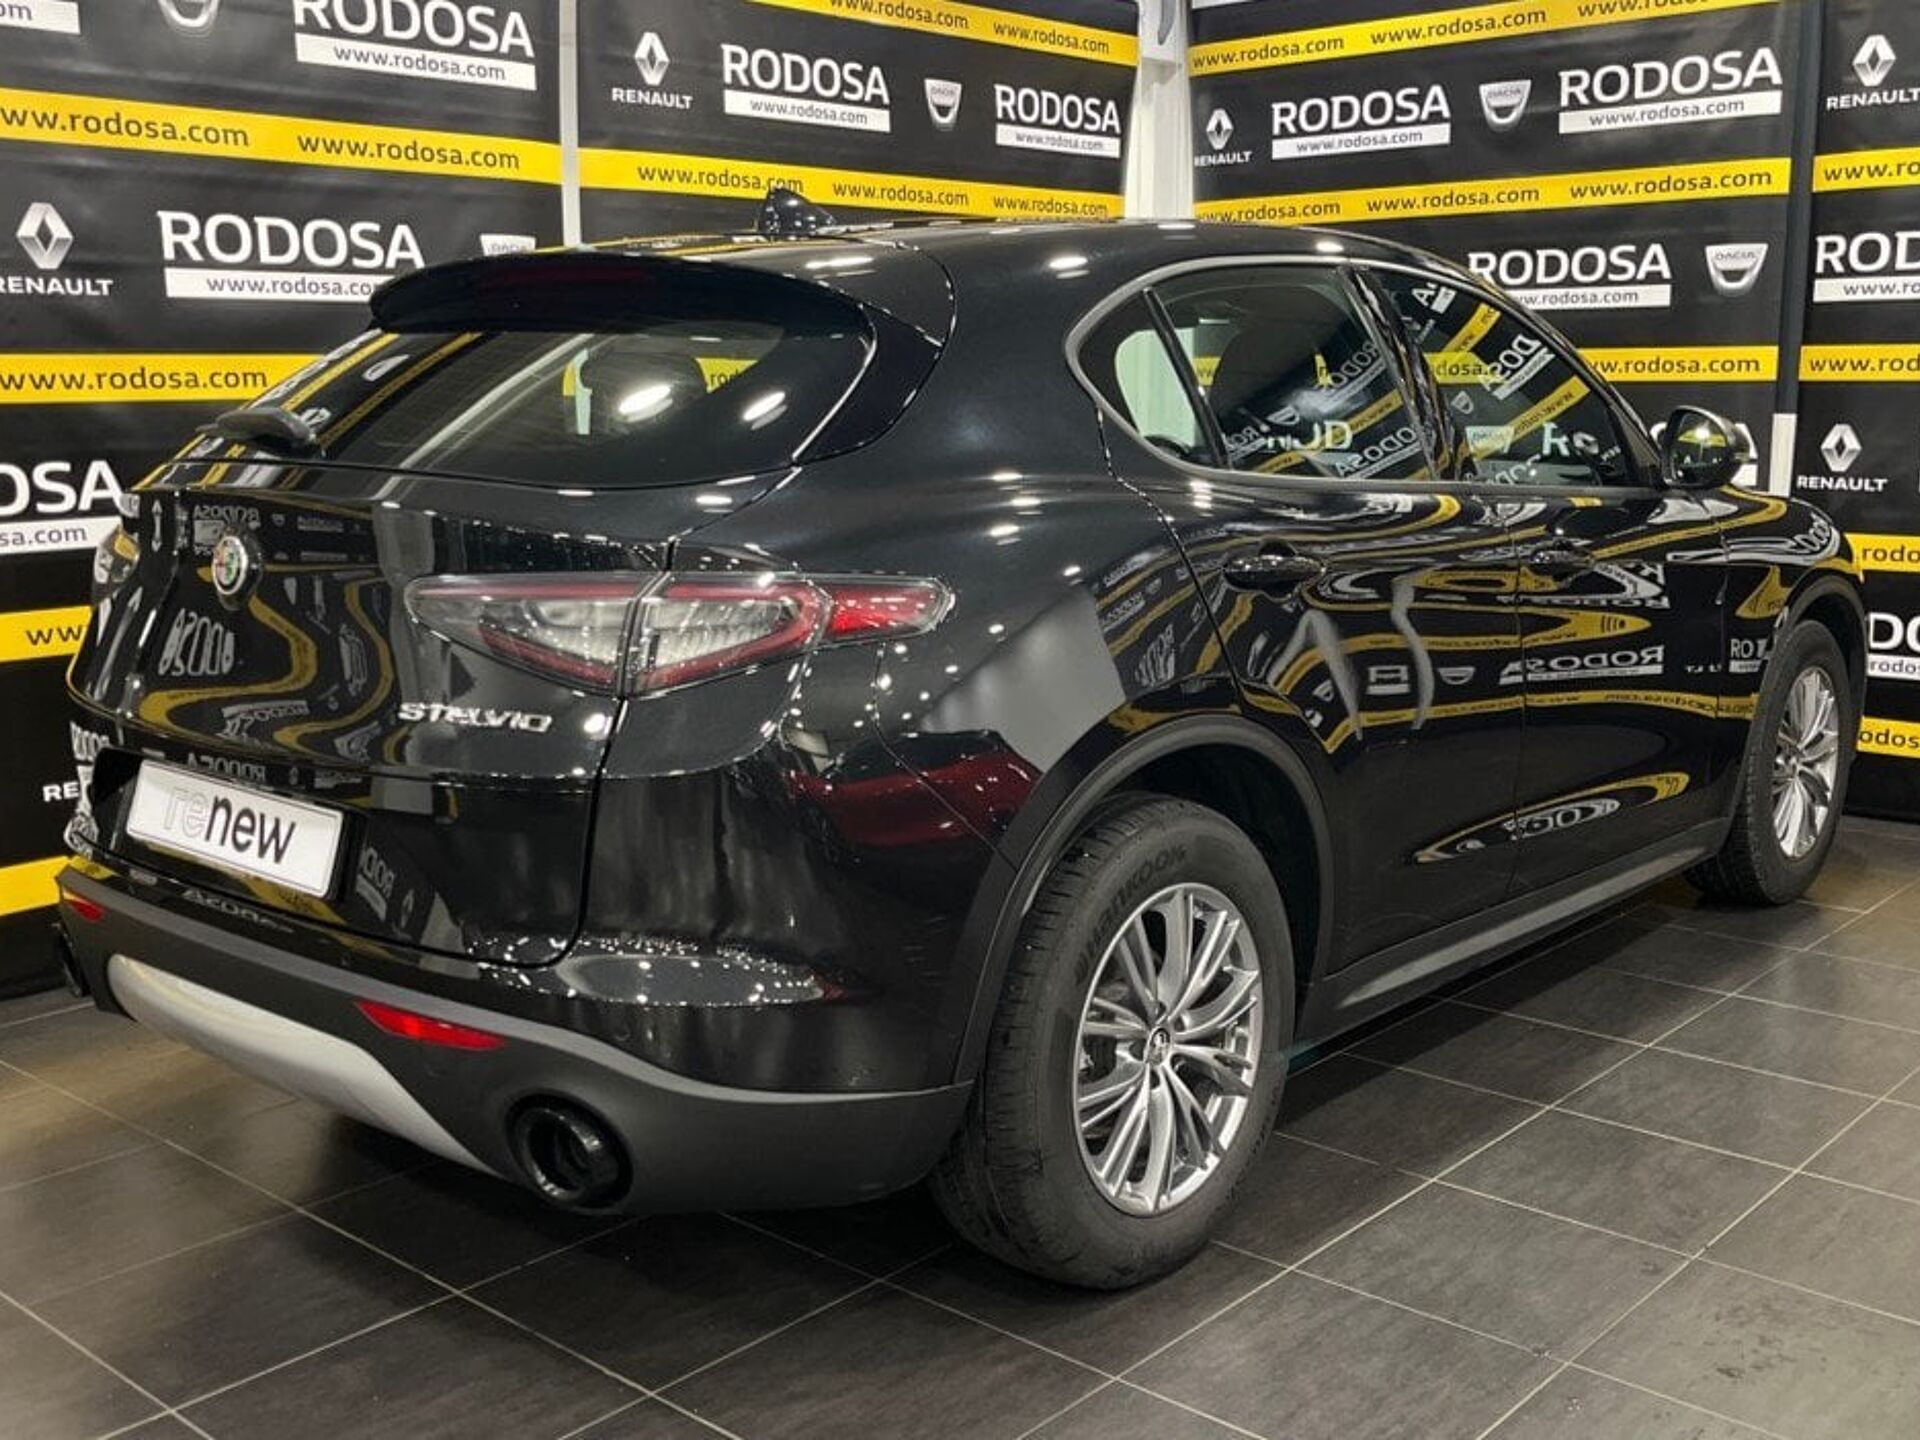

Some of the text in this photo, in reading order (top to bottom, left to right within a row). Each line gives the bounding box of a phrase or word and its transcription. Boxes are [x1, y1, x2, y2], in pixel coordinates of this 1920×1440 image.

[293, 0, 535, 57] RODOSA
[830, 0, 968, 29] www.rodosa.com
[1370, 9, 1546, 44] www.rodosa.com
[993, 20, 1110, 54] www.rodosa.com
[334, 46, 506, 80] www.rodosa.com
[1192, 37, 1345, 68] www.rodosa.com
[721, 43, 890, 104] RODOSA
[1558, 47, 1783, 107] RODOSA
[612, 87, 693, 109] RENAULT
[750, 99, 868, 124] www.rodosa.com
[994, 84, 1121, 134] RODOSA
[1271, 84, 1450, 135] RODOSA
[1826, 87, 1920, 111] RENAULT
[1589, 100, 1745, 126] www.rodosa.com
[297, 135, 520, 169] www.rodosa.com
[1016, 131, 1104, 150] www.rodosa.com
[1296, 130, 1423, 152] www.rodosa.com
[832, 181, 969, 206] www.rodosa.com
[1570, 171, 1772, 198] www.rodosa.com
[993, 195, 1108, 216] www.rodosa.com
[1367, 187, 1540, 212] www.rodosa.com
[156, 210, 425, 269] RODOSA
[1468, 243, 1672, 285] RODOSA
[207, 277, 379, 296] www.rodosa.co
[0, 366, 267, 390] www.rodosa.com
[1797, 475, 1888, 492] RENAULT
[1870, 660, 1920, 676] rodo
[398, 702, 552, 733] STELVIO
